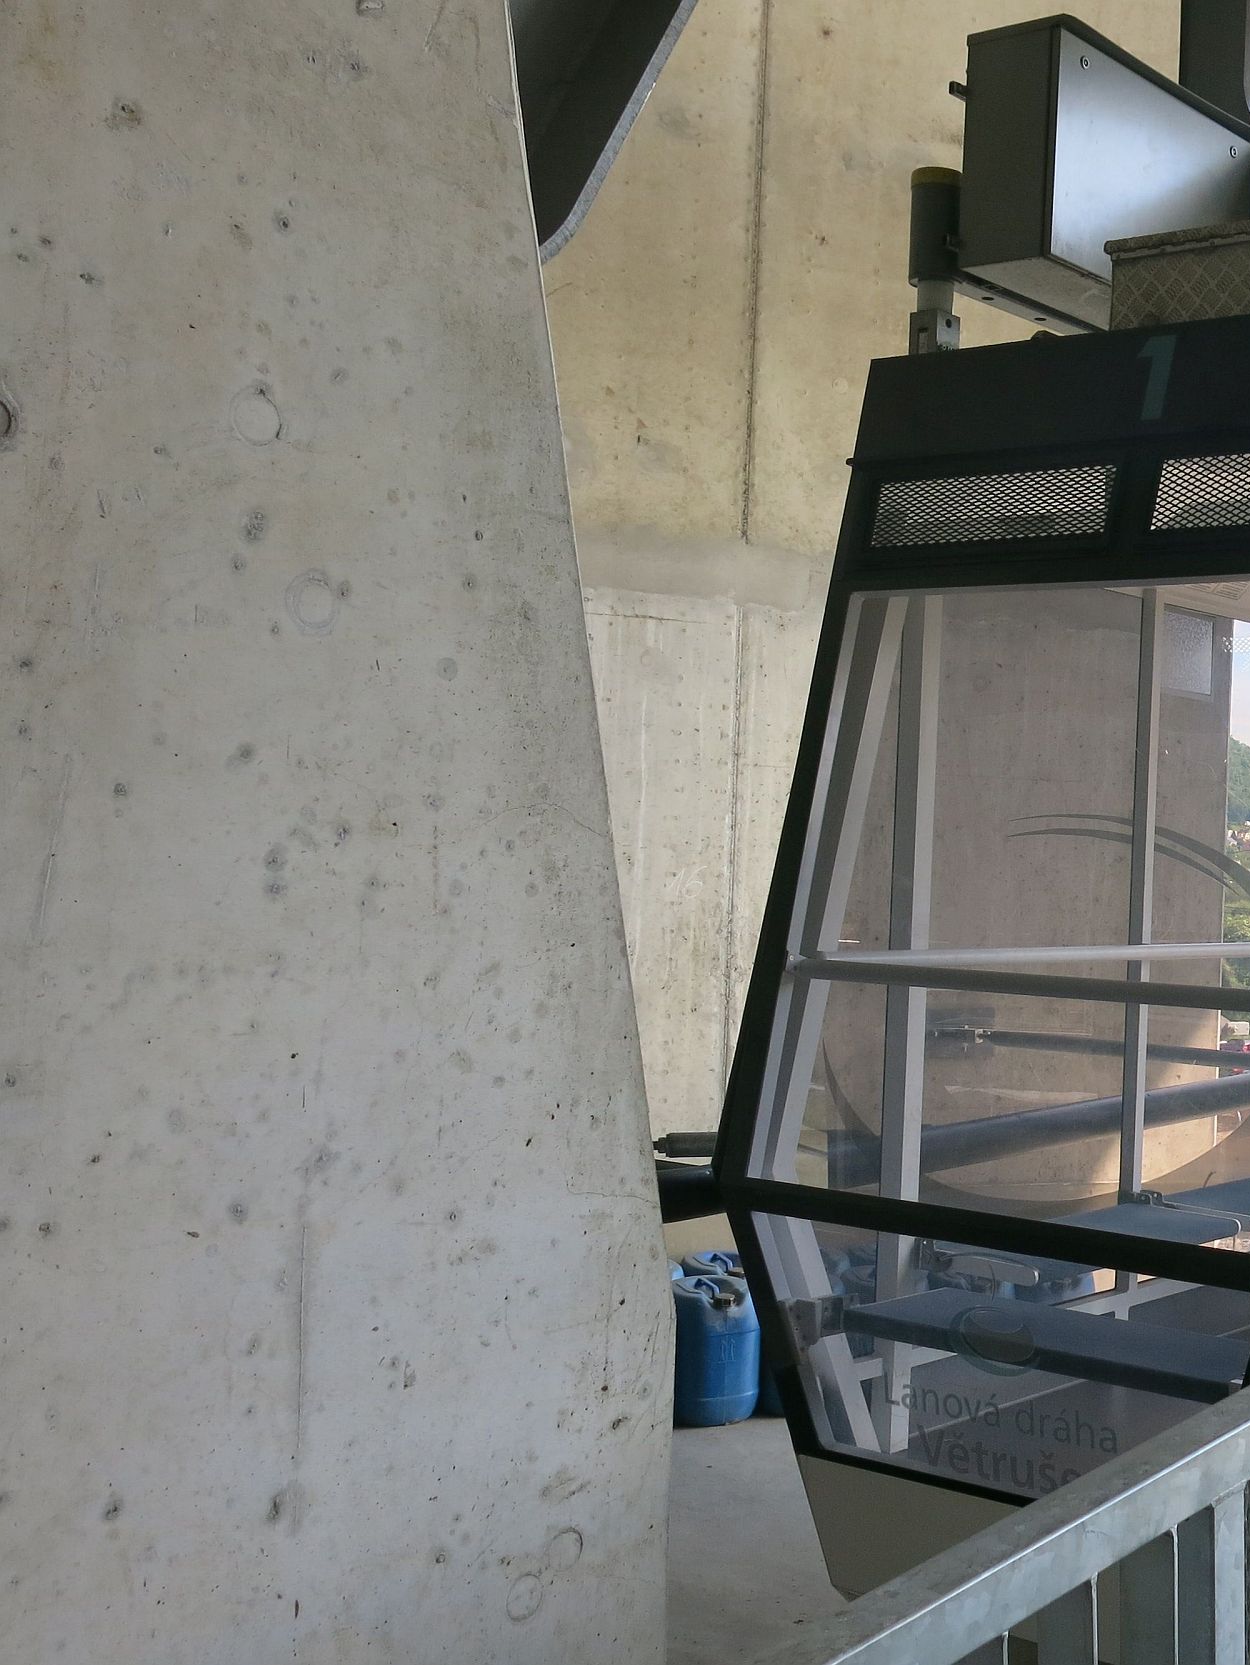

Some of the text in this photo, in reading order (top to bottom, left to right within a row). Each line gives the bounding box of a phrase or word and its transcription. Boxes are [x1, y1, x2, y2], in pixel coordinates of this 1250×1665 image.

[1137, 335, 1177, 420] 1
[883, 1372, 1118, 1454] Lanová dráha
